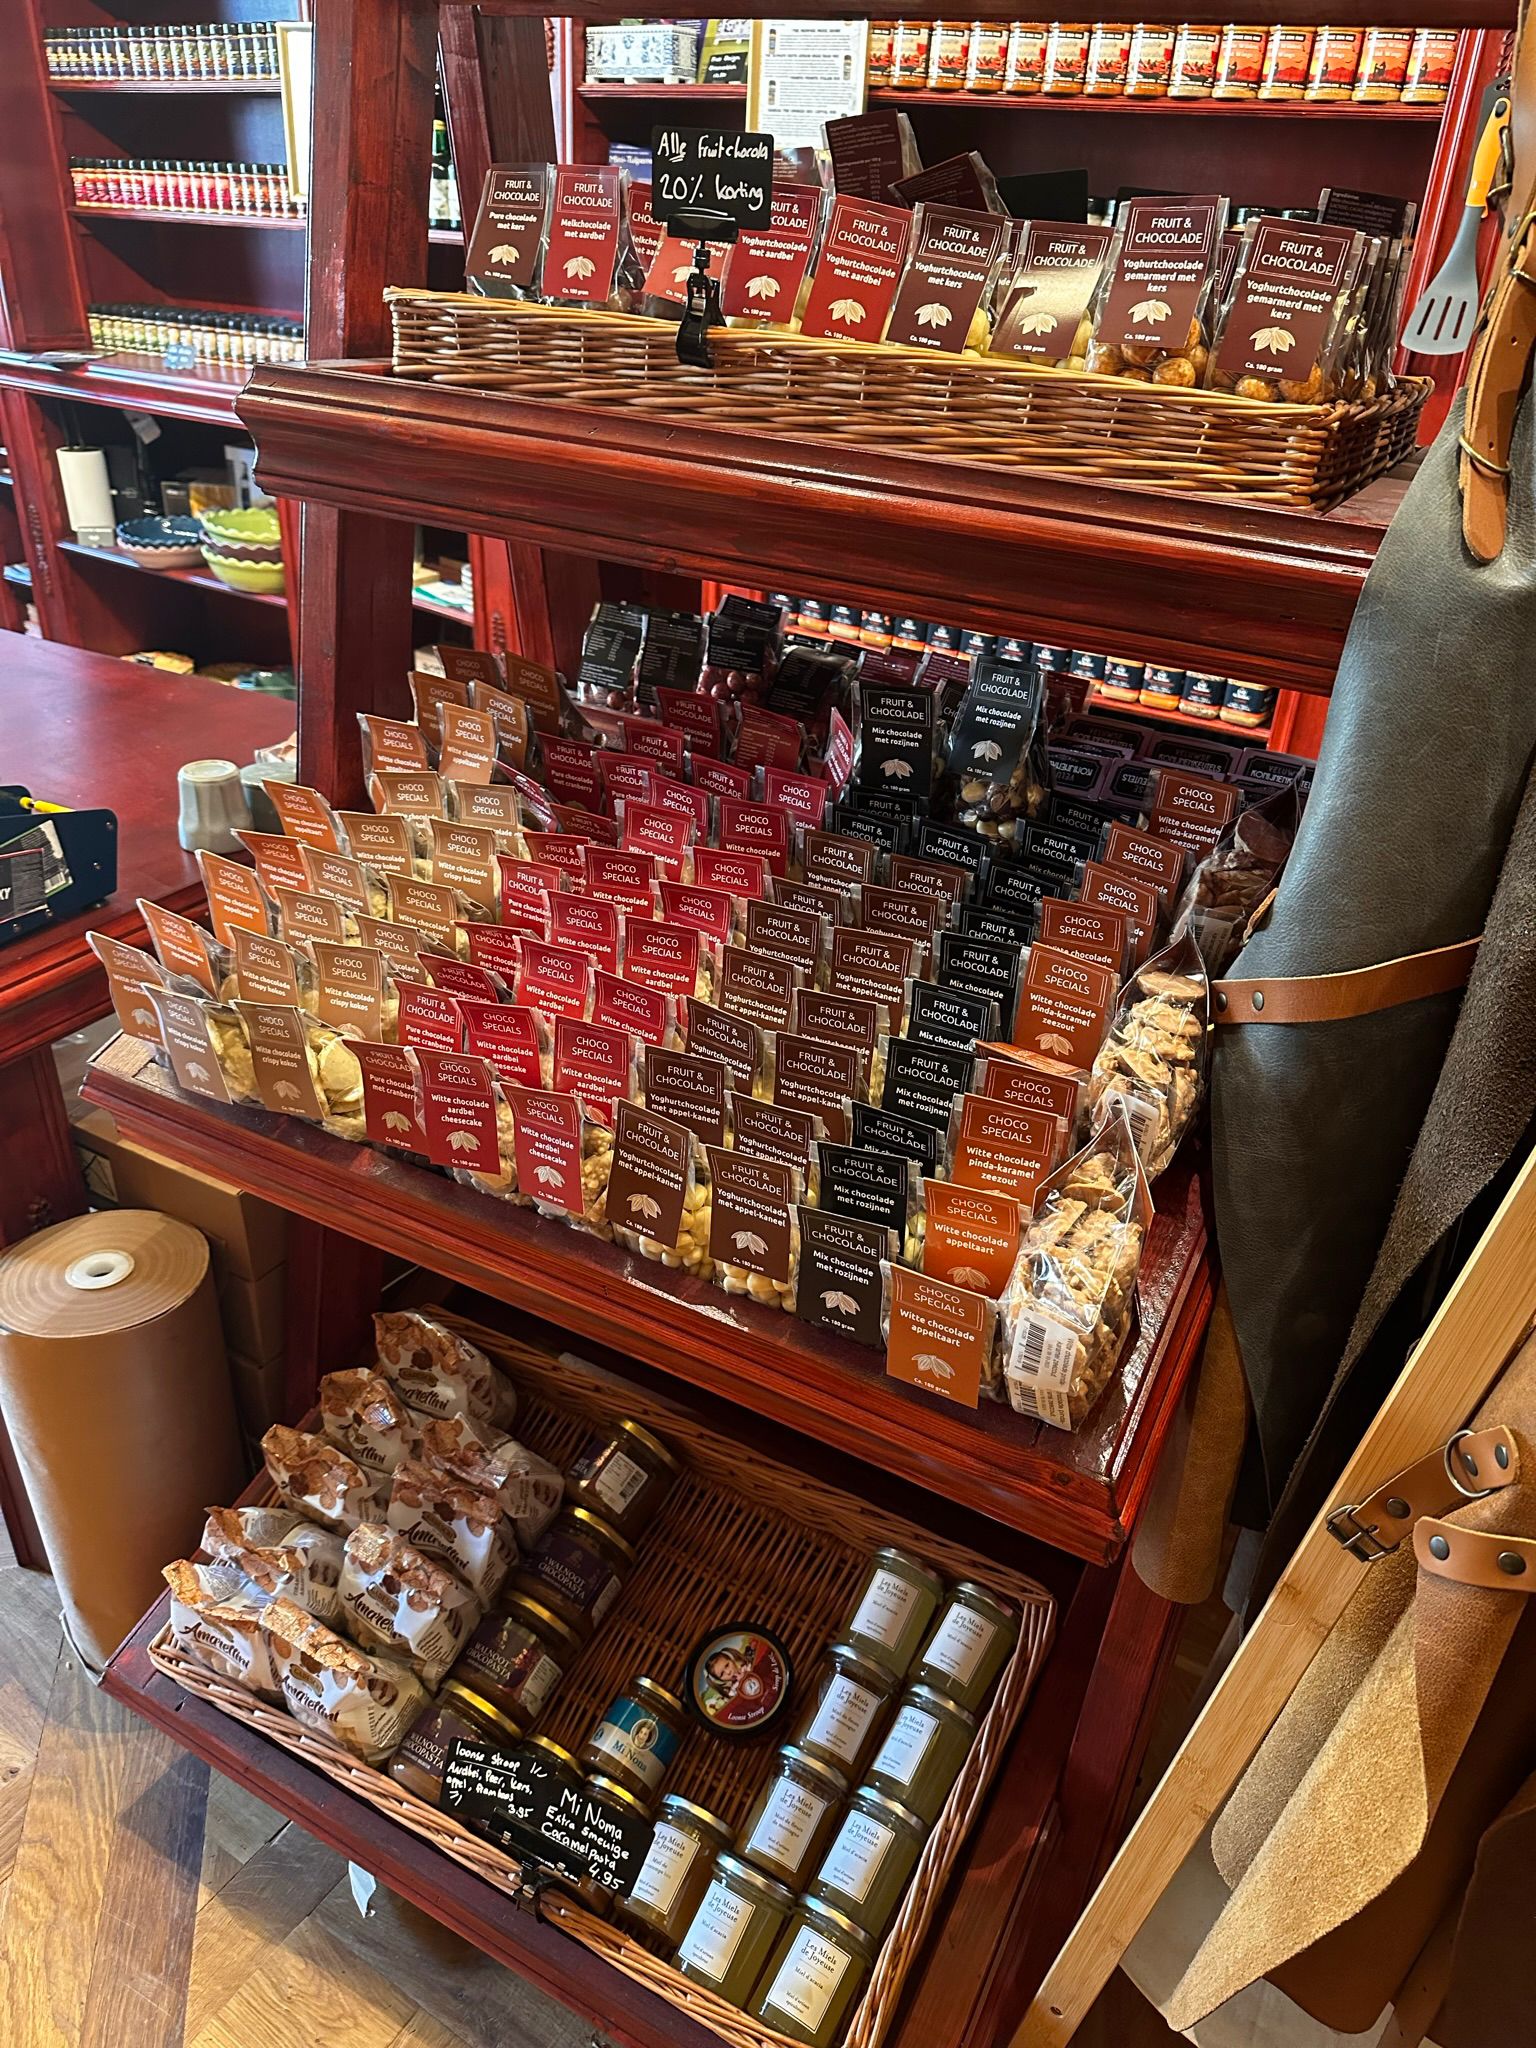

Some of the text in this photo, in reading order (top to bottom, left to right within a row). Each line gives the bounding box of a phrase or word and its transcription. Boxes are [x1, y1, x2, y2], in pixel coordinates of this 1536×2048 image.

[658, 132, 686, 156] Alle
[505, 180, 532, 190] FRUIT &
[574, 183, 604, 194] FRUIT &
[660, 174, 763, 210] 20% korting
[494, 191, 540, 202] CHOCOLADE
[563, 196, 612, 208] CHOCOLADE
[489, 212, 537, 222] Pure chocolade
[560, 218, 611, 230] Melkchocolade
[1151, 218, 1192, 228] FRUIT &
[497, 222, 525, 231] met kers
[852, 220, 888, 236] FRUIT &
[943, 226, 980, 242] FRUIT &
[564, 231, 605, 240] met aardbei
[742, 235, 808, 252] Yoghurtchocolade
[838, 230, 897, 254] CHOCOLADE
[1135, 232, 1203, 244] CHOCOLADE
[749, 249, 794, 260] met aardbei
[928, 238, 988, 258] CHOCOLADE
[1048, 243, 1086, 254] FRUIT &
[1280, 240, 1324, 258] FRUIT &
[826, 252, 896, 278] Yoghurtchocolade
[1033, 256, 1095, 268] CHOCOLADE
[1123, 259, 1204, 271] Yoghurtchocolade
[1261, 254, 1334, 276] CHOCOLADE
[834, 268, 882, 286] met aardbei
[914, 262, 984, 282] Yoghurtchocolade
[1124, 272, 1196, 282] gemarmerd met
[928, 276, 963, 289] met kers
[1147, 283, 1167, 292] kers
[1247, 280, 1332, 302] Yoghurtchocolade
[1246, 293, 1323, 314] gemarmerd met
[1270, 308, 1292, 320] kers
[881, 698, 905, 706] FRUIT
[871, 708, 924, 720] CHOCOLADE
[887, 730, 922, 739] chocolade
[891, 738, 919, 747] rozijnen
[739, 814, 769, 825] CHOCO
[735, 825, 772, 836] SPECIALS
[726, 844, 780, 857] Witte chocolade
[334, 957, 362, 968] CHOCO
[332, 968, 367, 981] SPECIALS
[1052, 965, 1087, 982] CHOCO
[1044, 975, 1090, 995] SPECIALS
[324, 987, 374, 1003] Witte chocolade
[330, 999, 368, 1011] crispy kokos
[1030, 993, 1096, 1019] Witte chocolade
[1031, 1004, 1090, 1027] pinda-karamel
[1042, 1017, 1075, 1032] zeezout
[440, 1063, 470, 1073] CHOCO
[438, 1073, 477, 1086] SPECIALS
[431, 1094, 489, 1108] Witte chocolade
[448, 1107, 475, 1115] aardbei
[441, 1114, 482, 1127] cheesecake
[988, 1114, 1029, 1131] CHOCO
[638, 1123, 670, 1143] FRUIT &
[982, 1125, 1032, 1144] SPECIALS
[626, 1130, 679, 1160] CHOCOLADE
[618, 1149, 683, 1182] Yoghurtchocolade
[966, 1145, 1041, 1169] Witte chocolade
[618, 1160, 681, 1190] met appel-kaneel
[969, 1158, 1035, 1179] pinda-karamel
[981, 1172, 1018, 1187] zeezout
[951, 1197, 992, 1213] CHOCO
[947, 1206, 997, 1224] SPECIALS
[824, 1224, 864, 1242] FRUIT &
[934, 1222, 1008, 1247] Witte chocolade
[812, 1230, 878, 1257] CHOCOLADE
[946, 1238, 994, 1255] appeltaart
[813, 1250, 874, 1277] Mix chocolade
[816, 1261, 869, 1285] met rozijnen
[919, 1285, 960, 1304] CHOCO
[914, 1293, 965, 1317] SPECIALS
[900, 1309, 975, 1342] Witte chocolade
[911, 1324, 960, 1347] appeltaart
[934, 1384, 950, 1395] gram
[606, 1729, 636, 1757] Mi Noma
[508, 1803, 533, 1818] 3.95
[560, 1788, 623, 1840] Mi Noma
[540, 1821, 589, 1855] Caramel
[545, 1805, 630, 1860] Extra smeuige
[852, 1820, 880, 1840] Les Miels
[854, 1829, 878, 1848] Joyeuse
[587, 1863, 625, 1890] 4.95
[712, 1892, 739, 1915] Les Miels
[713, 1902, 738, 1922] Joyeuse
[800, 1947, 835, 1974] de Joyeuse
[806, 1939, 837, 1965] Les Miels
[795, 1966, 806, 1977] Miel
